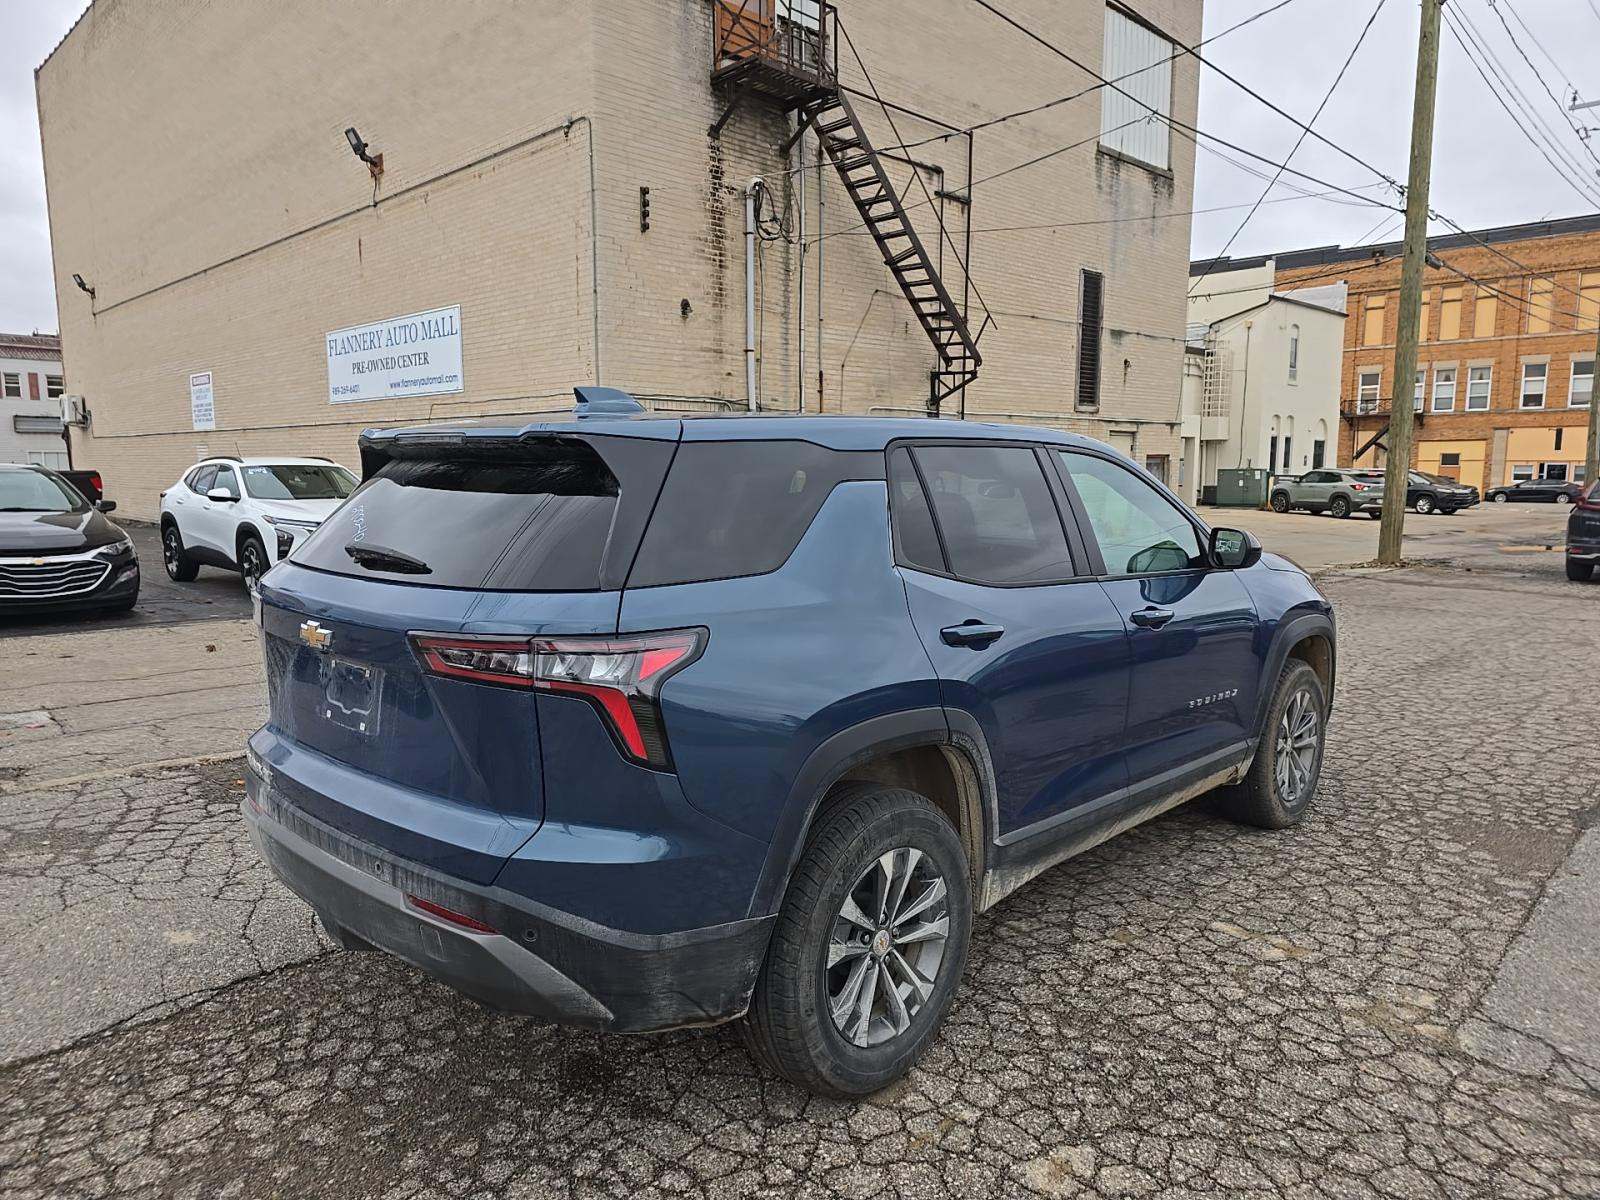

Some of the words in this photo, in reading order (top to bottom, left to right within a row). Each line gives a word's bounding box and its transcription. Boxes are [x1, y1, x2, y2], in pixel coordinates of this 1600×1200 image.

[328, 329, 384, 357] FLANNERY
[385, 322, 418, 348] AUTO
[421, 315, 458, 341] MALL
[352, 355, 396, 375] PRE-OWNED
[397, 352, 430, 370] CENTER
[389, 374, 458, 389] www.flanneryautomall.com
